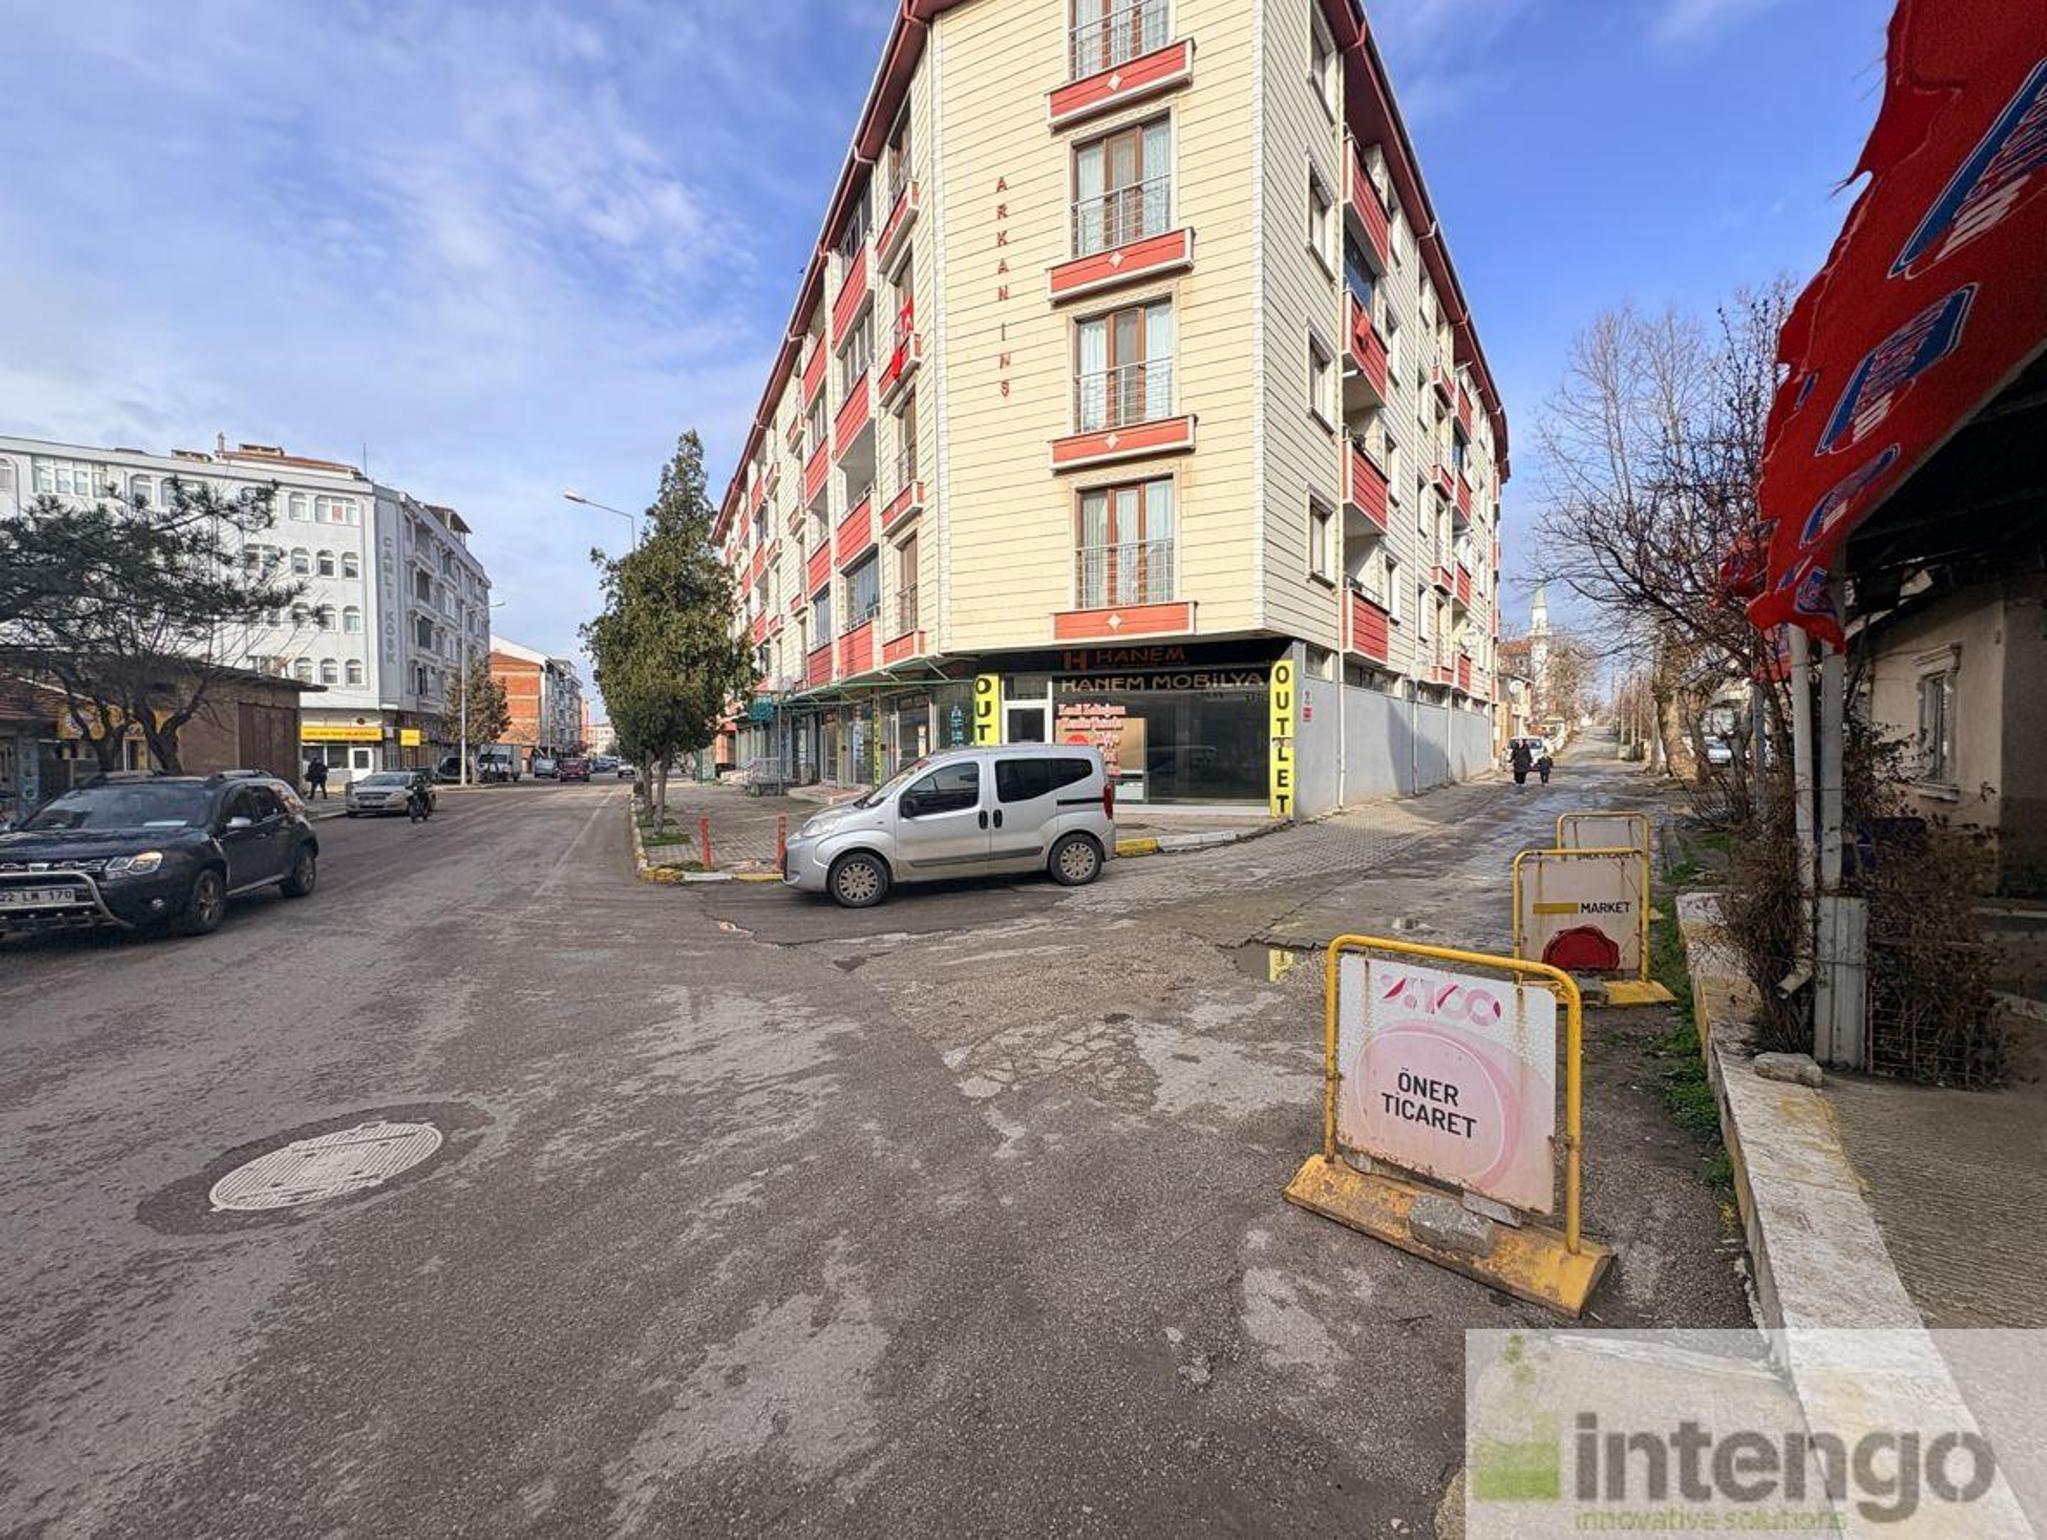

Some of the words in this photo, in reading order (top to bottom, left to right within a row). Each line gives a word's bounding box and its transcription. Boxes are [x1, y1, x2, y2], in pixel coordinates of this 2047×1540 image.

[996, 176, 1010, 301] ARKAN
[1096, 646, 1186, 665] HANEM
[1061, 676, 1144, 693] HANEM
[1275, 665, 1290, 814] OUTLET
[1580, 902, 1631, 914] MARKET
[1397, 1066, 1460, 1108] ÖNER
[1381, 1091, 1478, 1139] TİCARET
